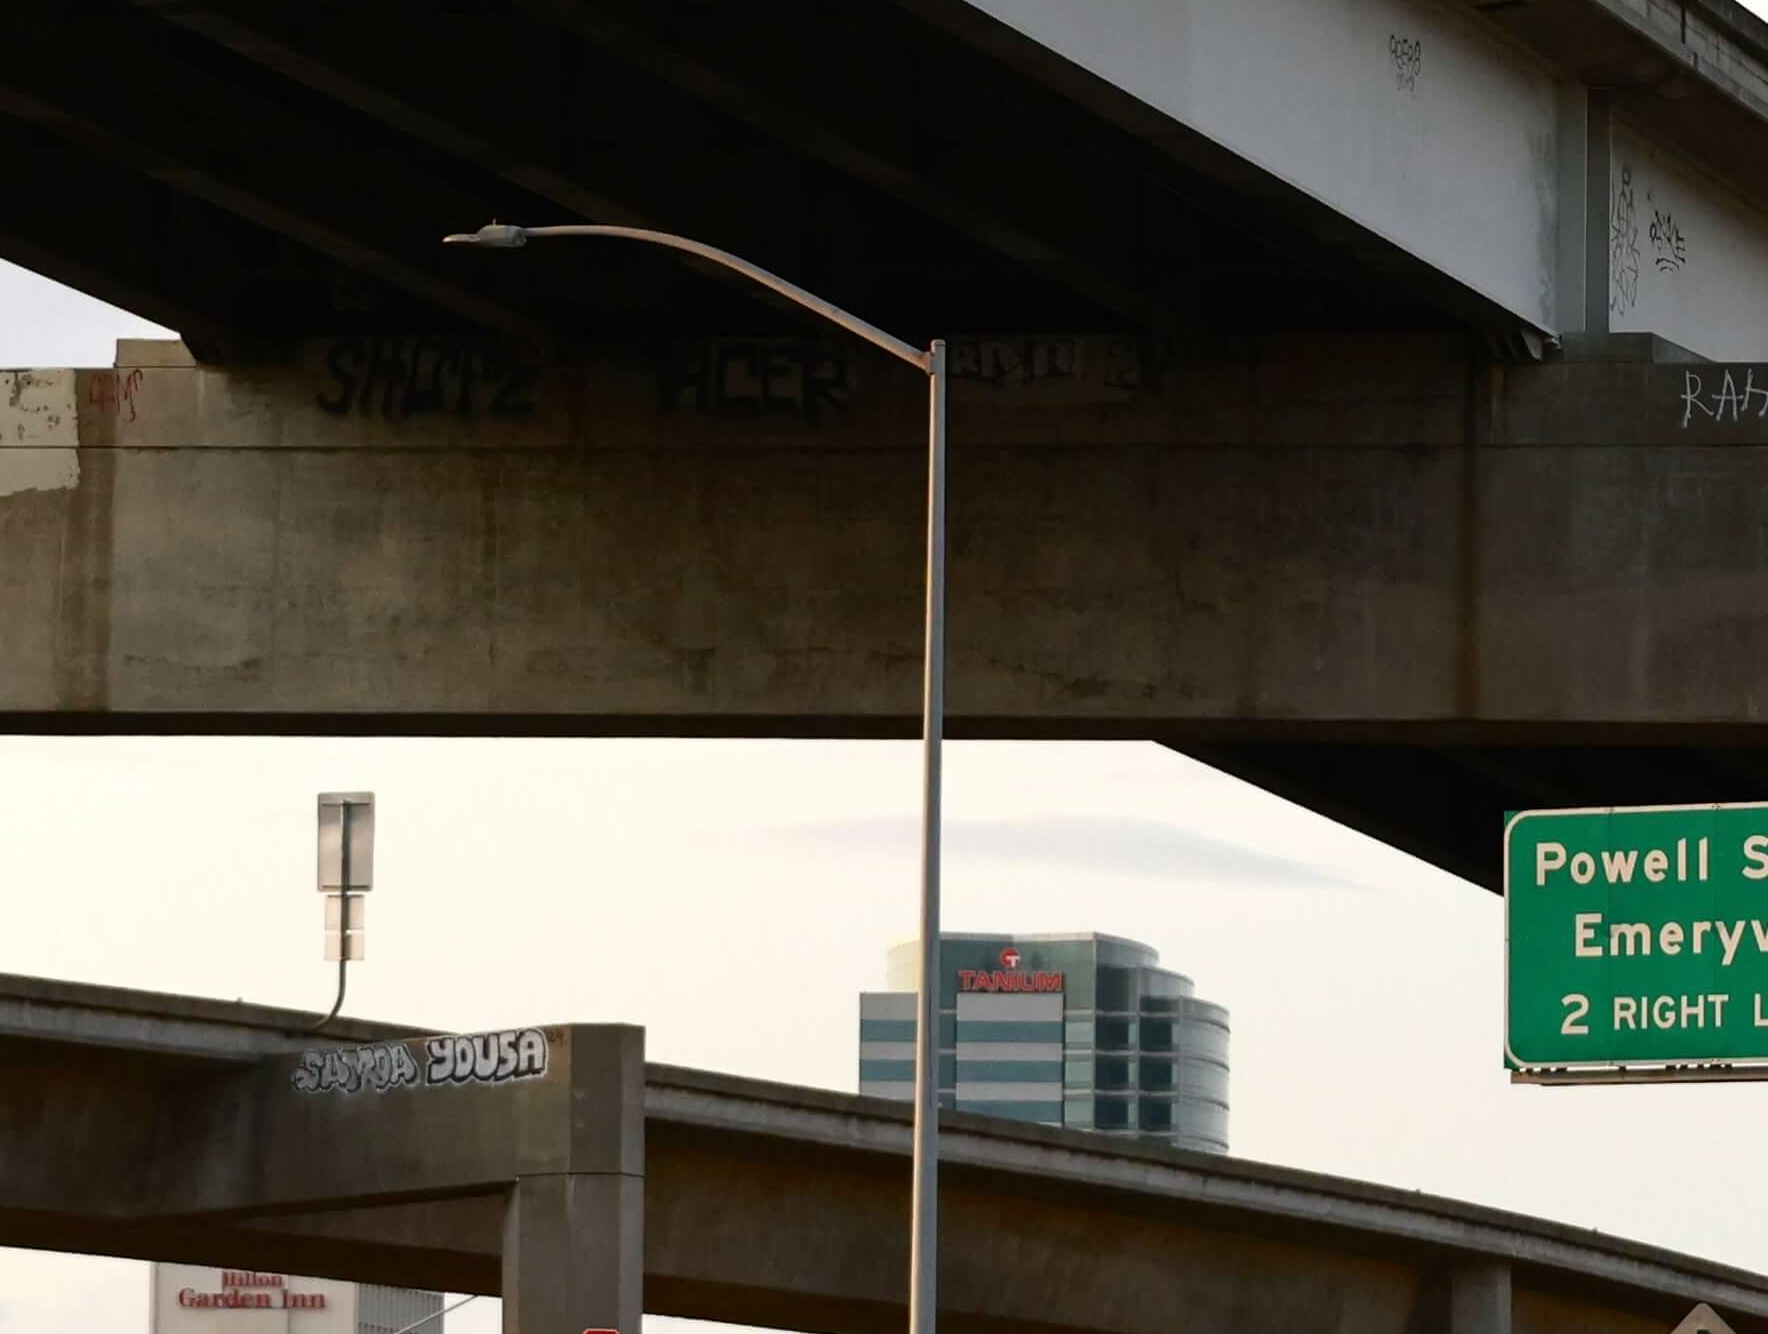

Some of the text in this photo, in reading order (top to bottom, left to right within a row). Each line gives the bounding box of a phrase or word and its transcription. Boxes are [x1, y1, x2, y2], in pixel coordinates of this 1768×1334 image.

[1535, 837, 1709, 885] Powell
[958, 970, 1065, 992] TANIUM
[1560, 993, 1590, 1035] 2
[1613, 993, 1729, 1030] RIGHT
[178, 1287, 326, 1308] Garden Inn
